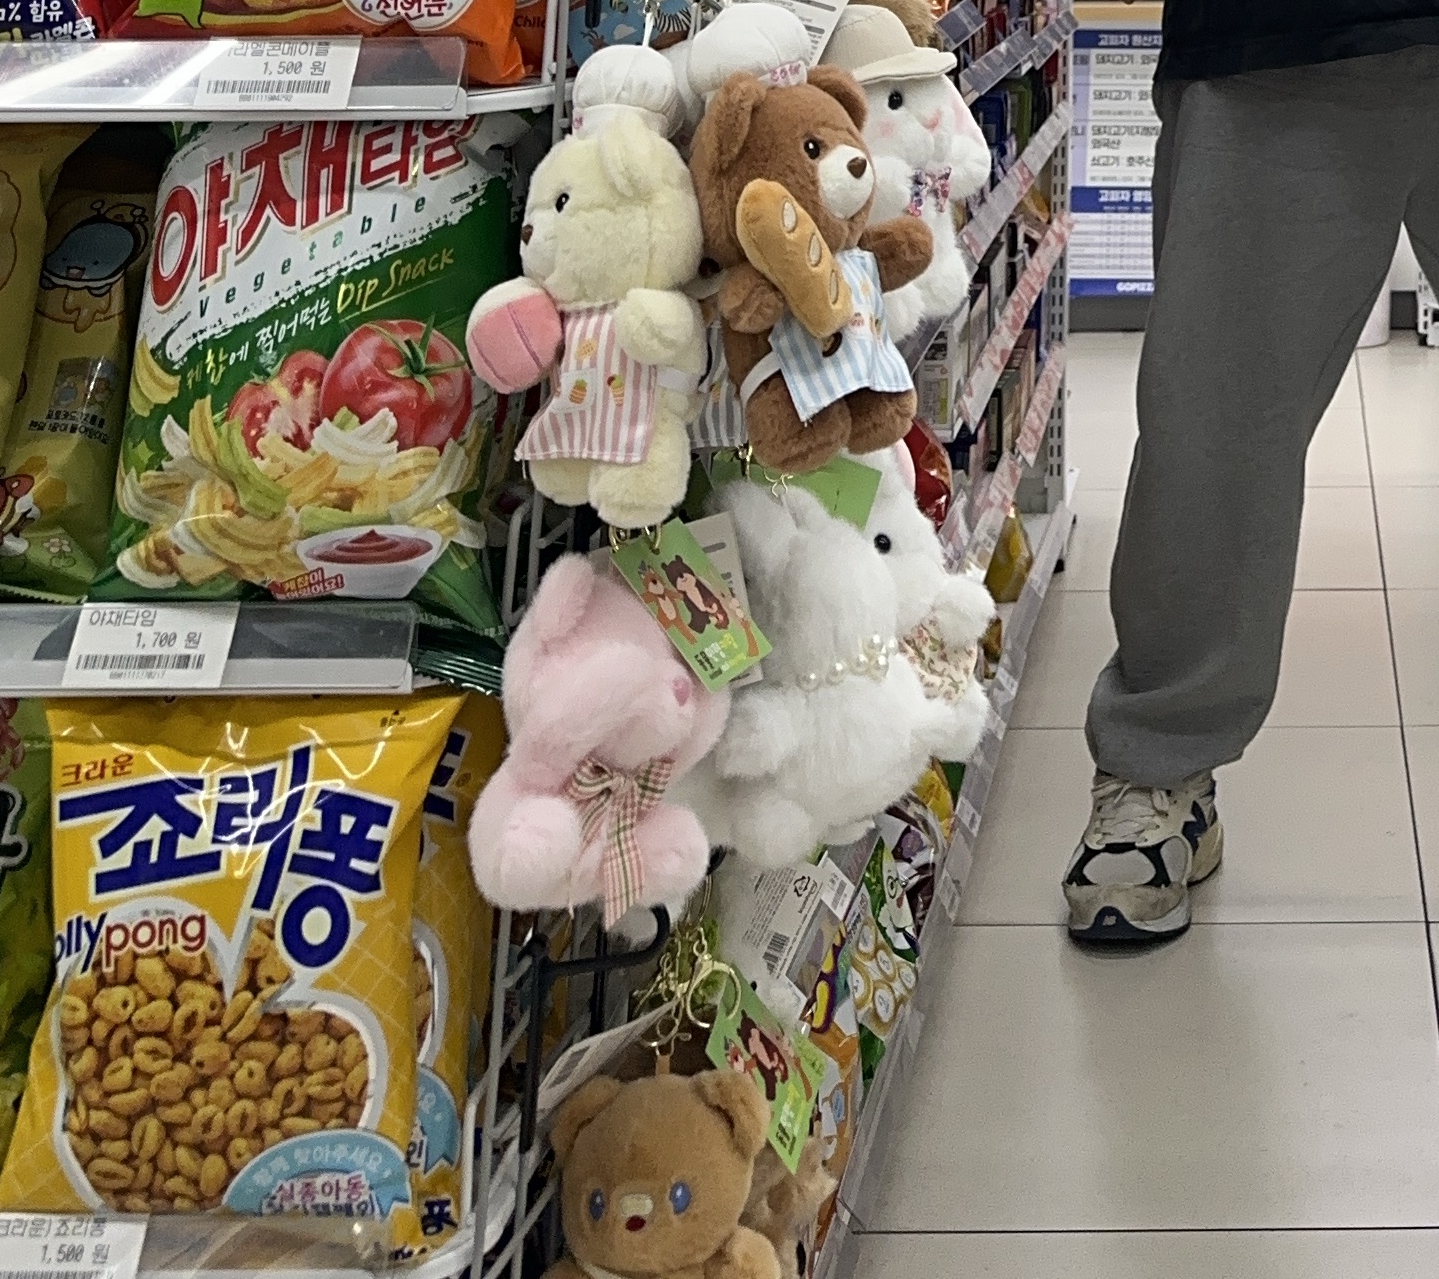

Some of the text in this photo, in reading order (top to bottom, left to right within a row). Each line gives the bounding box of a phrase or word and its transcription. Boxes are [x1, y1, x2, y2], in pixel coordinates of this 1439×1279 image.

[263, 60, 328, 77] 1,500 원
[151, 121, 486, 310] 야채타임
[336, 275, 380, 314] Dip
[382, 247, 456, 298] Snack
[89, 609, 157, 628] 야채타임
[135, 632, 202, 649] 1,700 원
[59, 753, 135, 787] 크라운
[56, 742, 400, 971] 죠리퐁
[39, 1244, 85, 1264] 1,500
